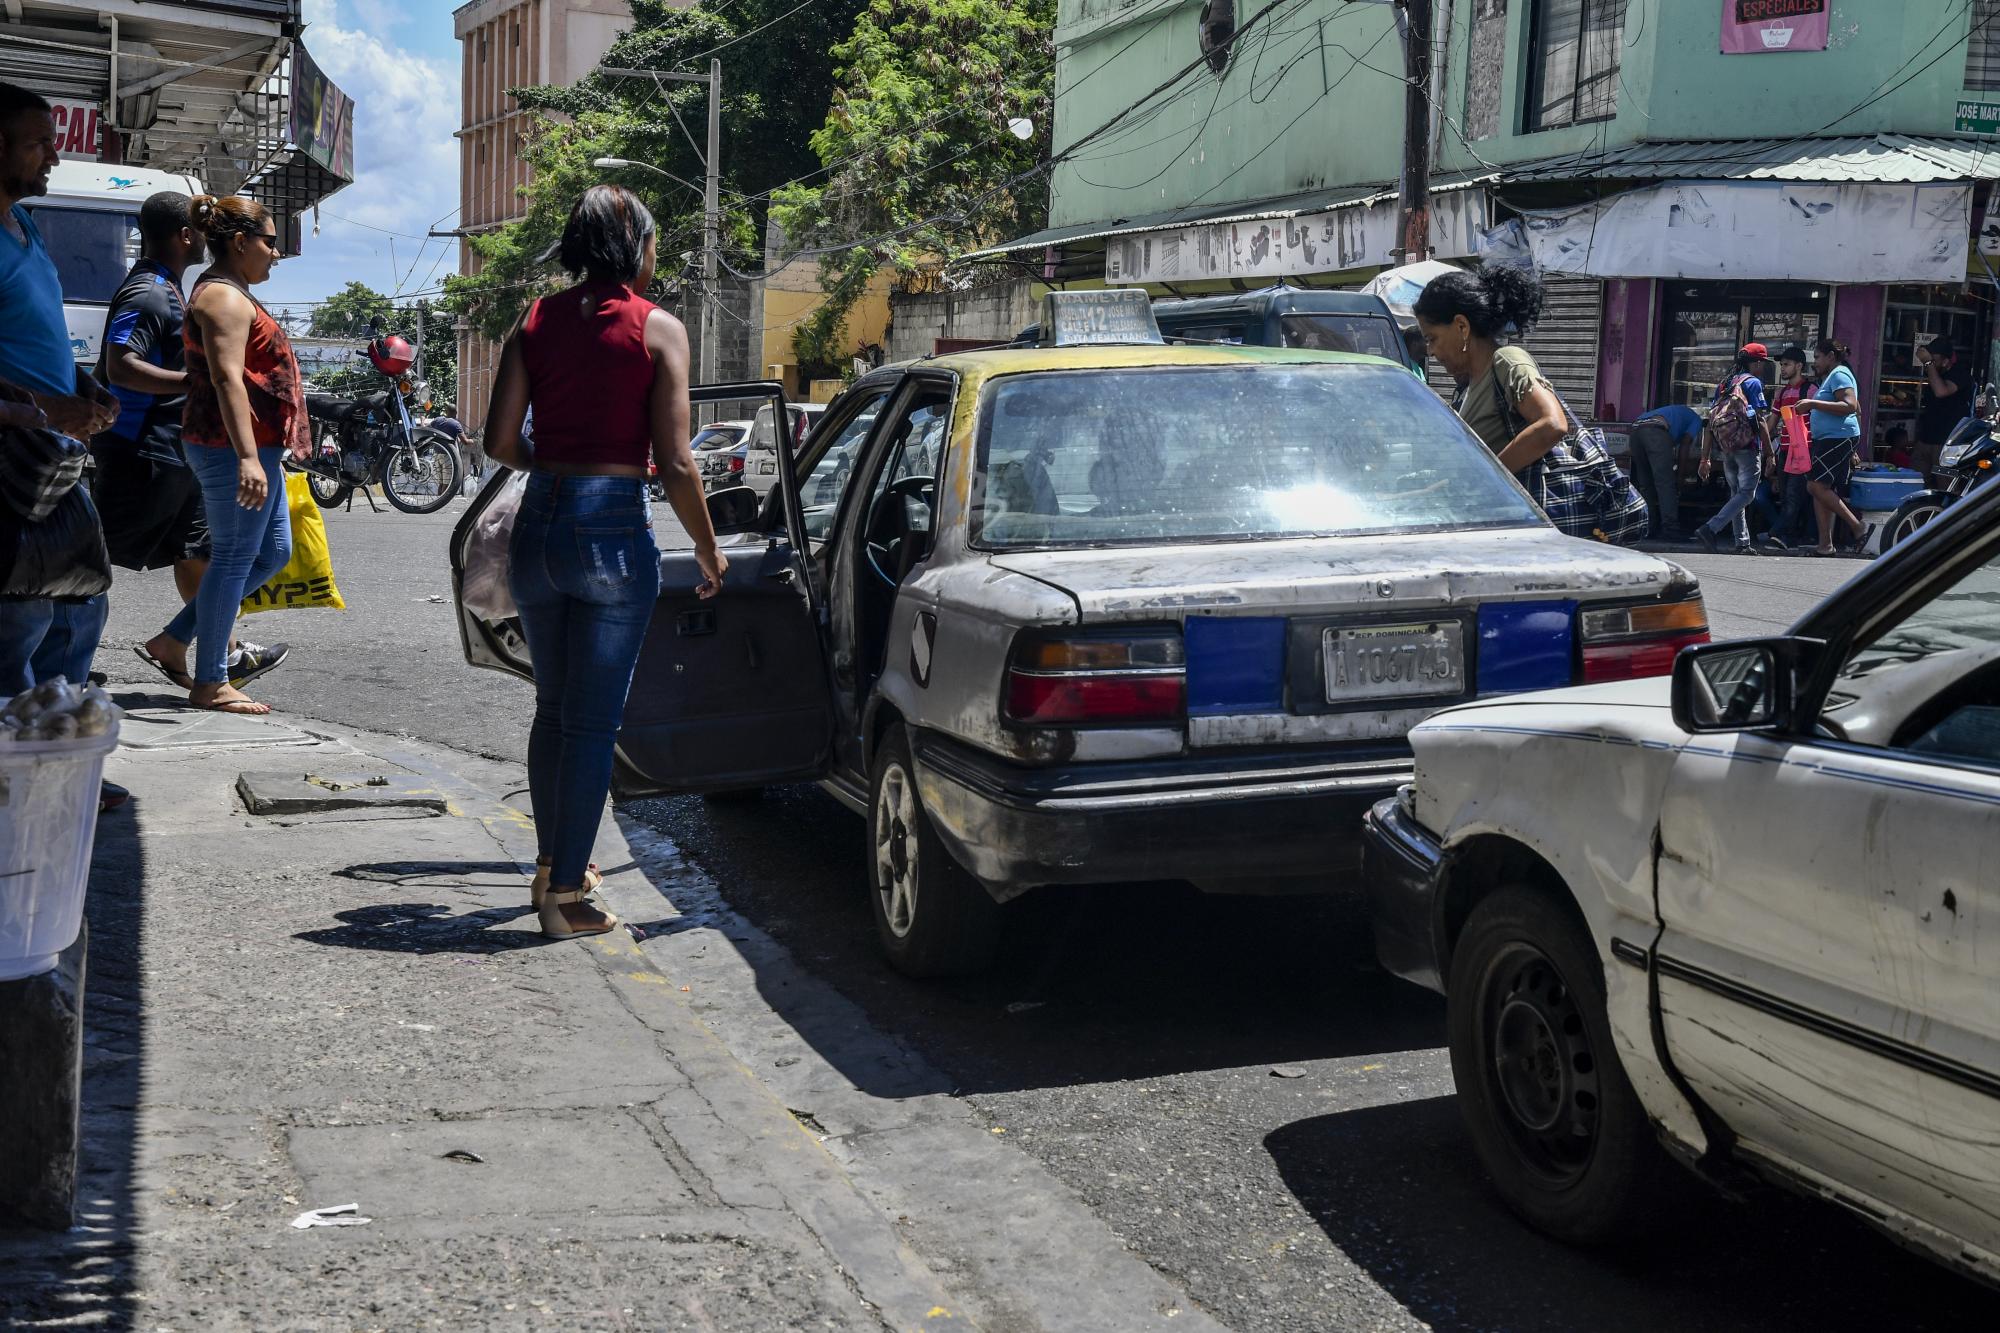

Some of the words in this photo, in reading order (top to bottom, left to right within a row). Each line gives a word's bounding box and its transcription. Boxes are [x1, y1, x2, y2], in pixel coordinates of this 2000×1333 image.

[1743, 0, 1818, 17] ESPECIALES
[1957, 103, 1978, 119] JOSÉ
[1057, 291, 1146, 304] MAMEYES
[1088, 306, 1107, 332] 12
[1108, 306, 1124, 318] JOSE
[1061, 321, 1089, 333] CALLE
